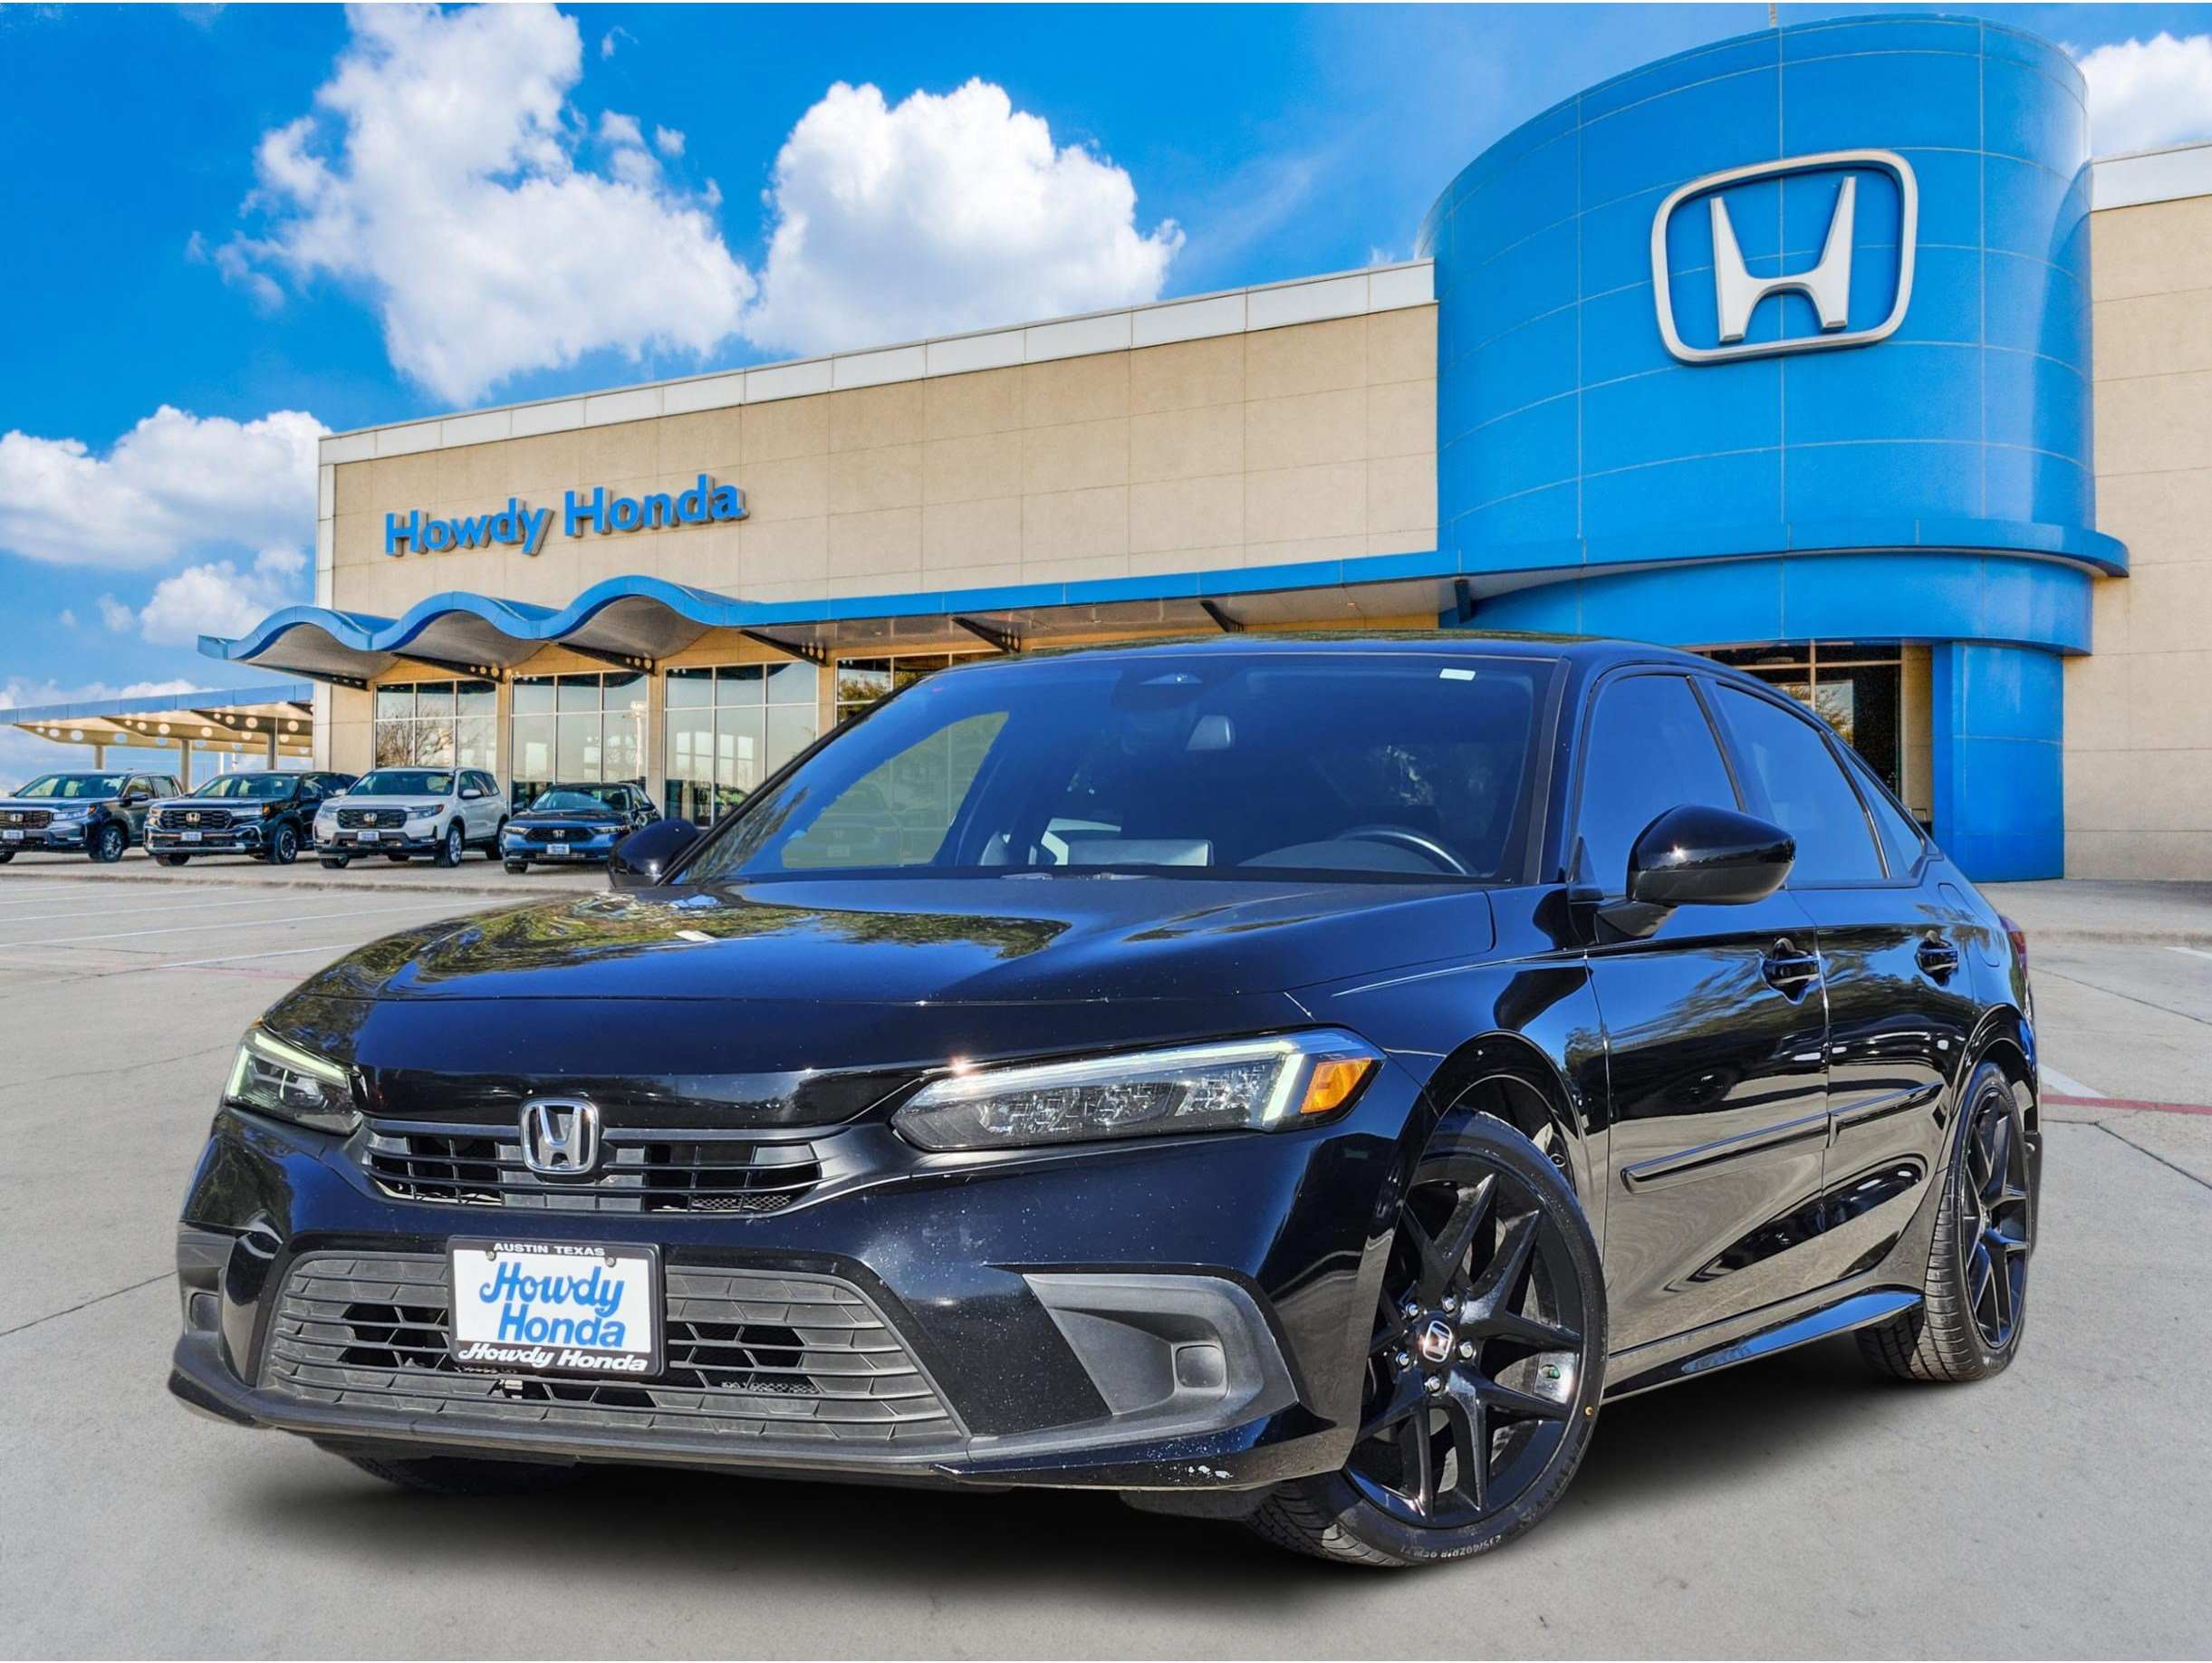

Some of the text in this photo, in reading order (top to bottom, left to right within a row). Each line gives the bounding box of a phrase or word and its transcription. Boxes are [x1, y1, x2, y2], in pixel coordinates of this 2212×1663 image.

[385, 473, 750, 556] Howdy Honda
[494, 1243, 605, 1257] AUSTIN TEXAS
[479, 1261, 625, 1318] Howdy
[497, 1303, 626, 1348] Honda
[458, 1342, 648, 1372] Howdy Honda
